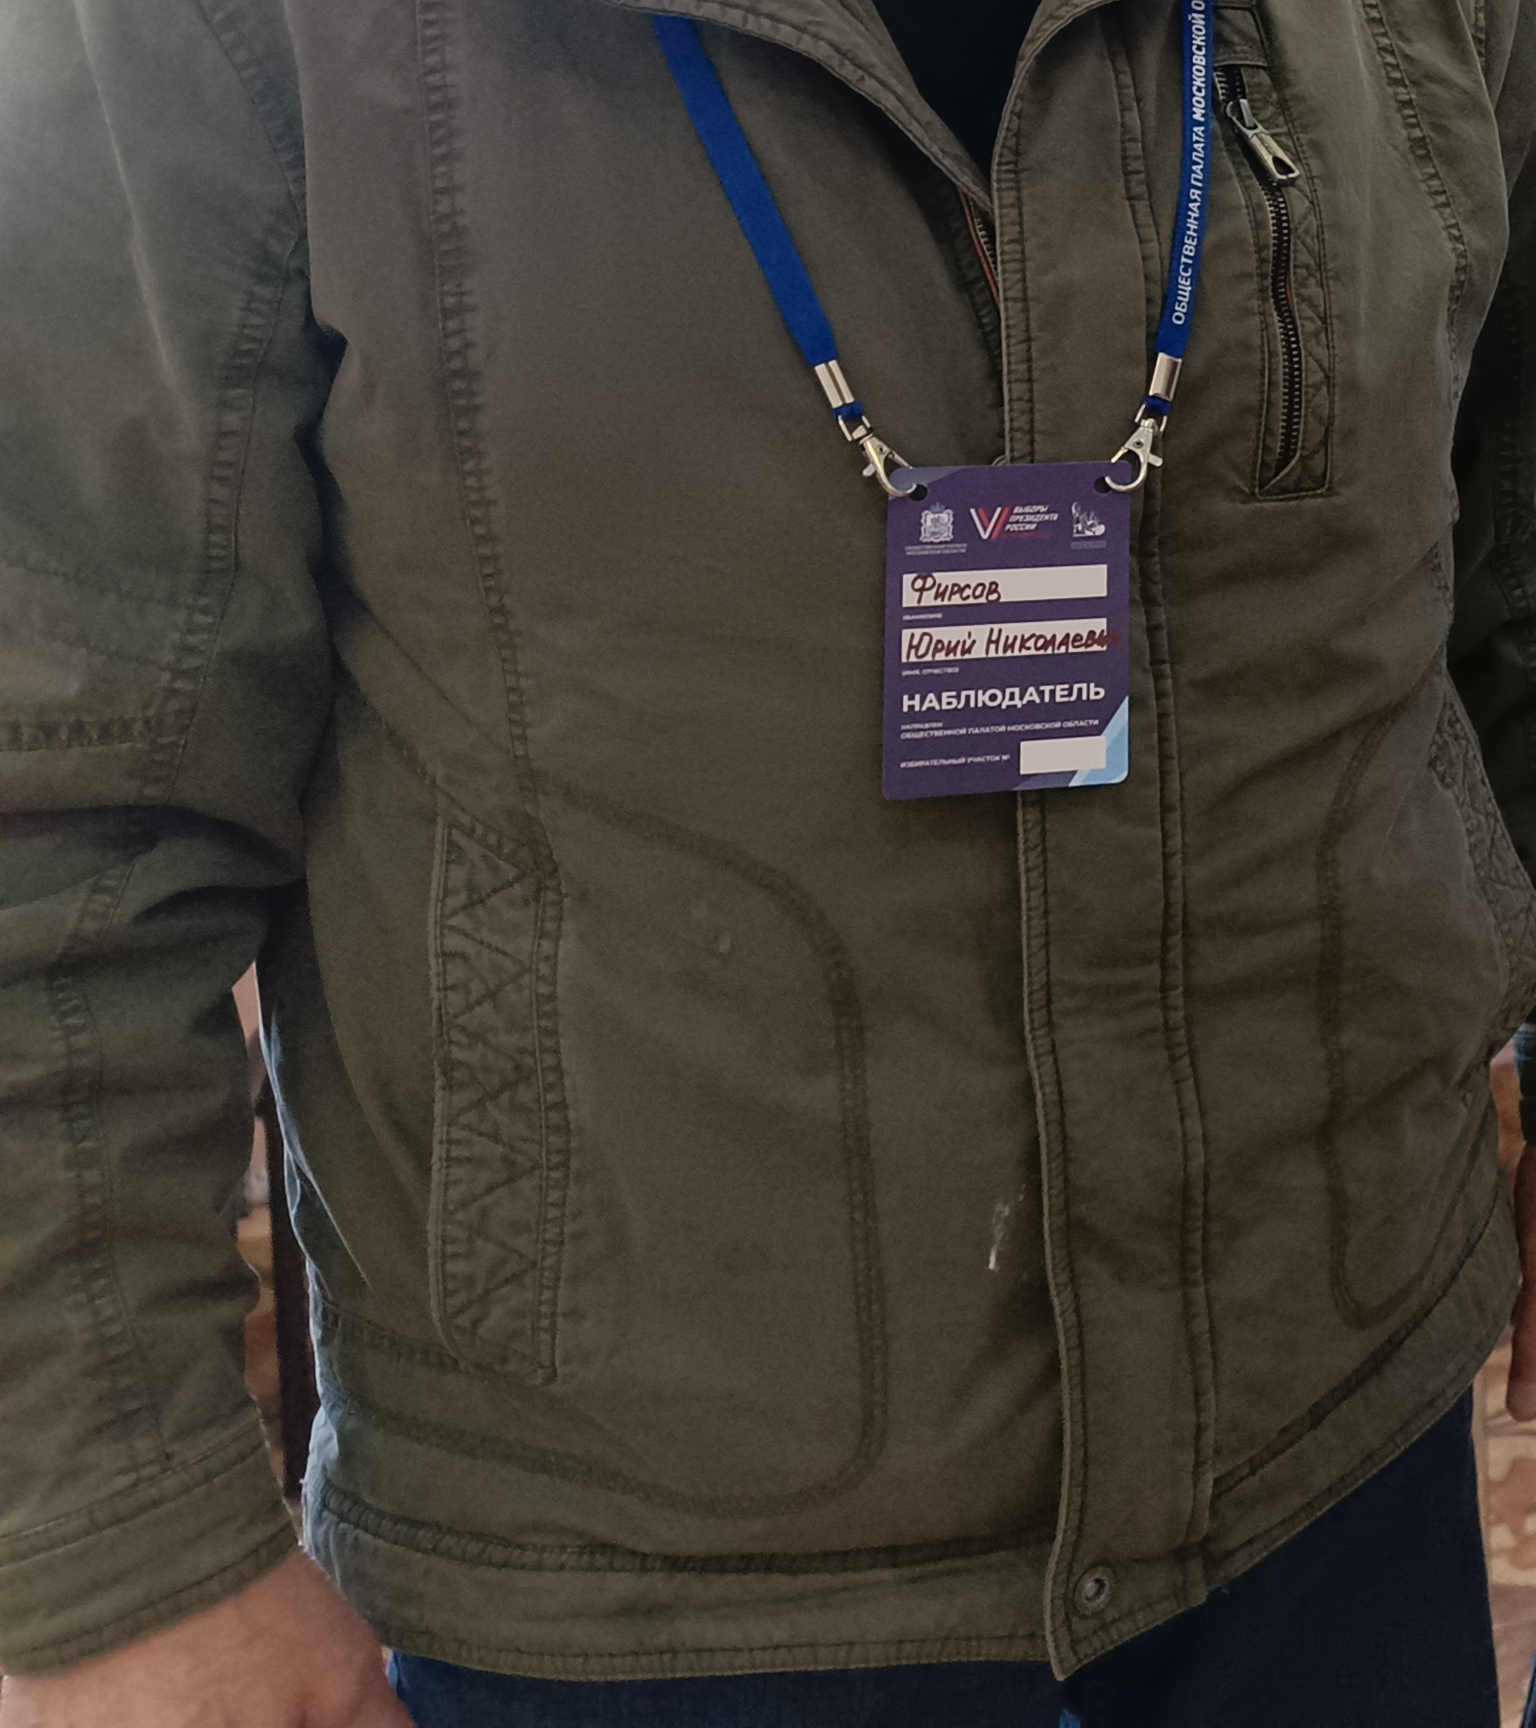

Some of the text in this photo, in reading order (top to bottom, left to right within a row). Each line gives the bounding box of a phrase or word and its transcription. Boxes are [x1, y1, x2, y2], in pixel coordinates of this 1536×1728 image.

[1188, 13, 1207, 123] МОСКОВСКОЙ
[1189, 124, 1207, 186] ПАЛАТА
[1172, 188, 1203, 325] ОБЩЕСТВЕННАЯ
[906, 631, 977, 662] Юрий
[902, 682, 1106, 713] НАБЛЮДАТЕЛЬ
[967, 724, 1007, 735] ПАЛАТОЙ
[1007, 720, 1062, 733] МОСКОВСКОЙ
[1062, 718, 1100, 729] ОБЛАСТИ
